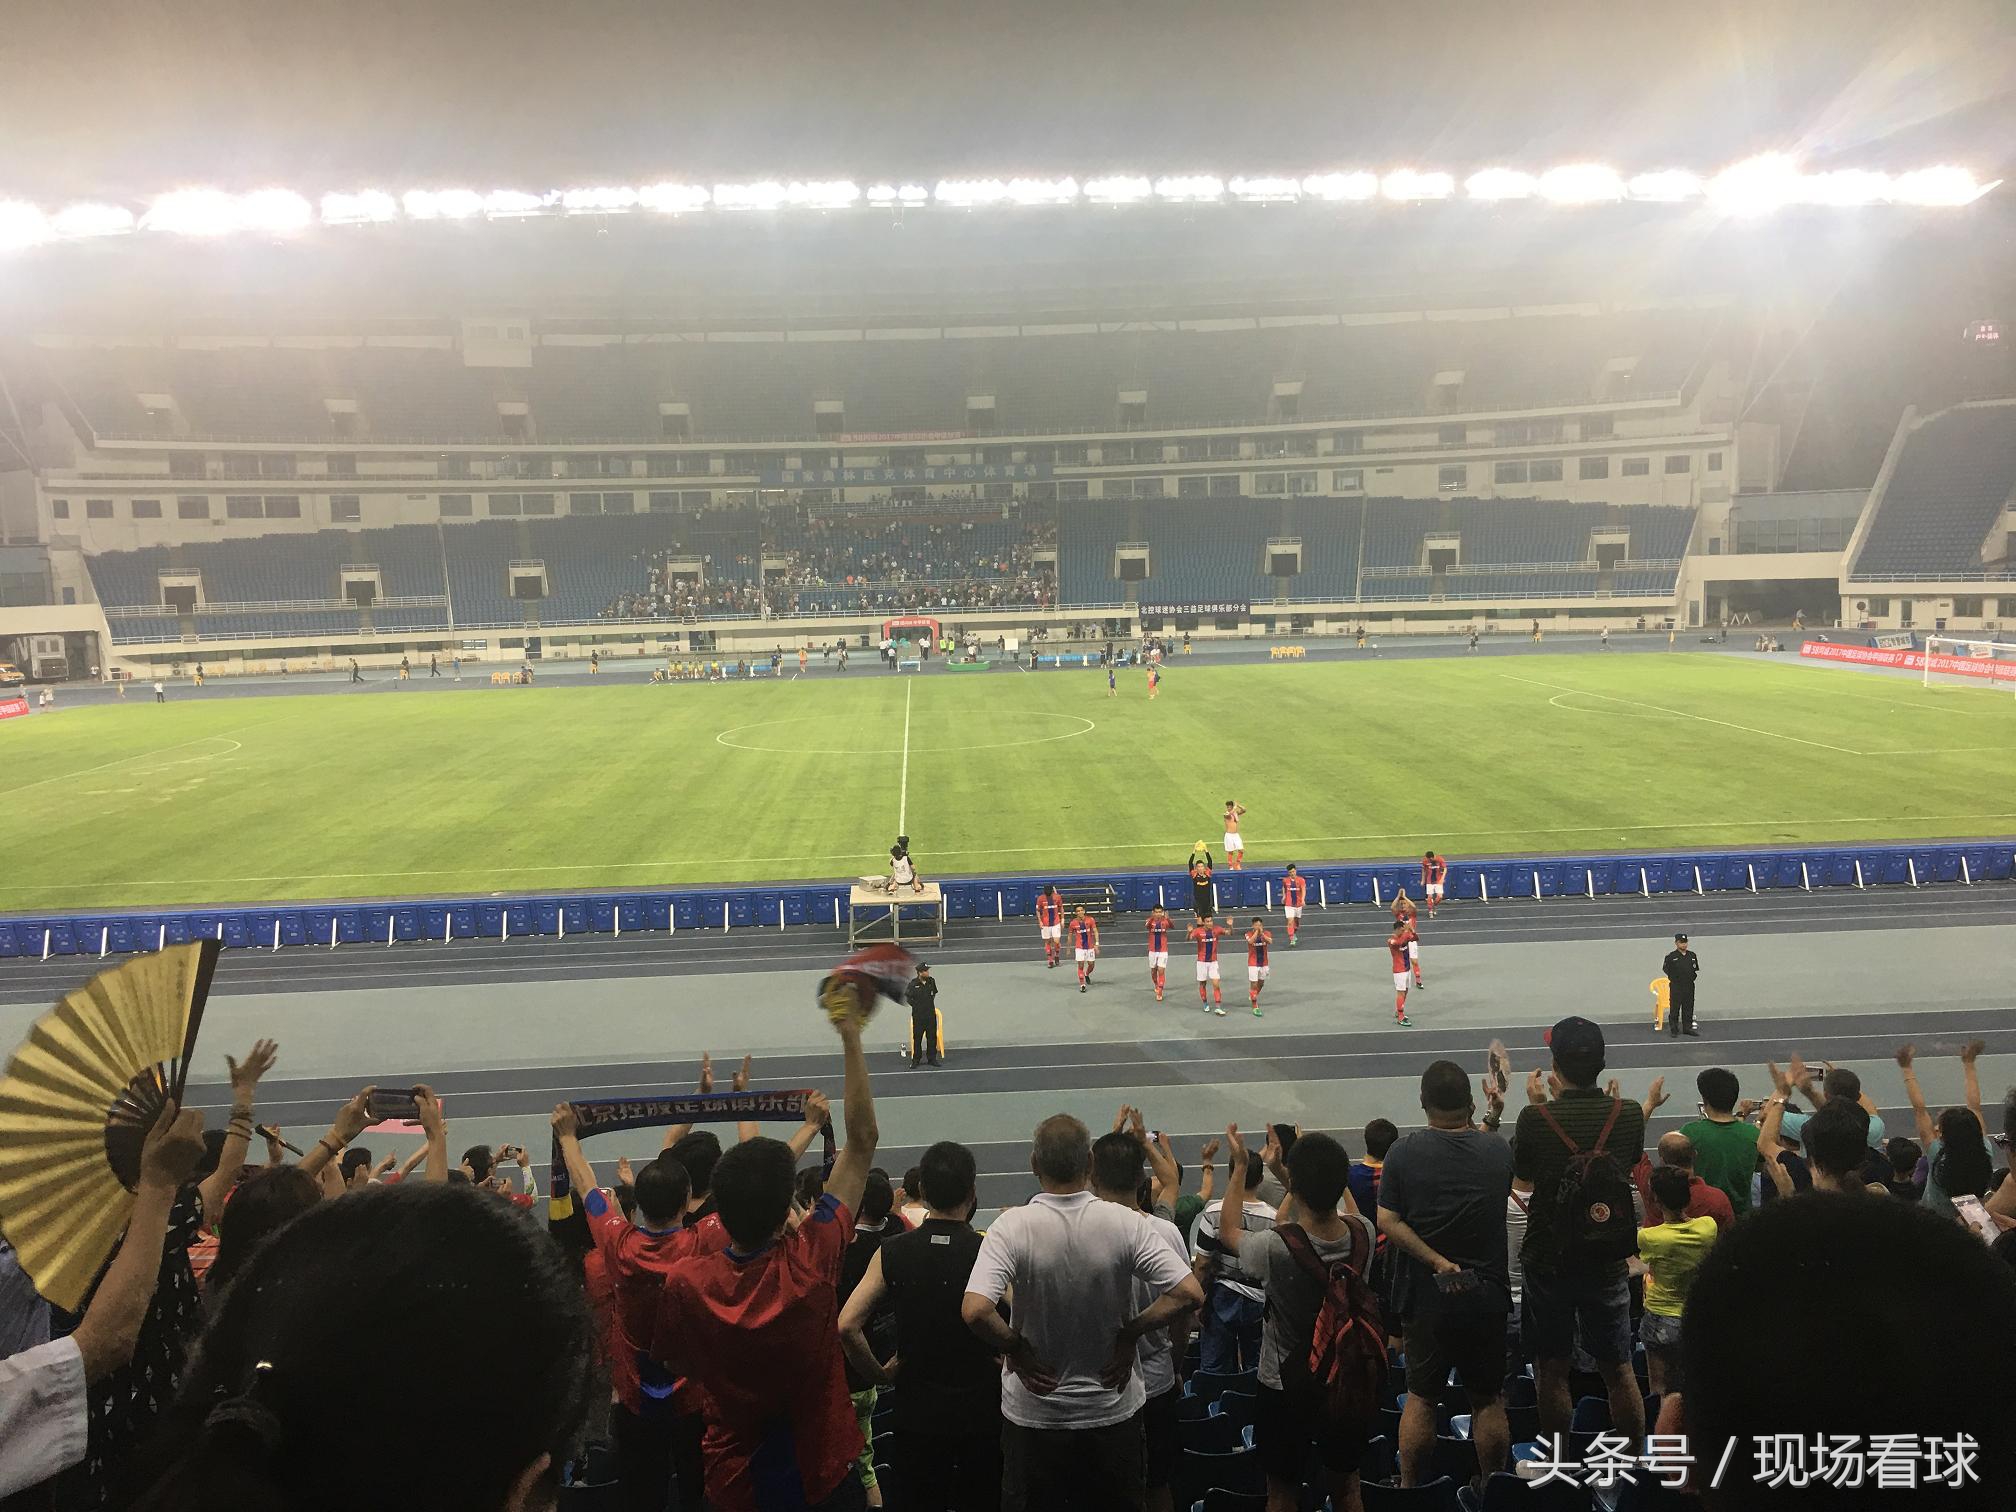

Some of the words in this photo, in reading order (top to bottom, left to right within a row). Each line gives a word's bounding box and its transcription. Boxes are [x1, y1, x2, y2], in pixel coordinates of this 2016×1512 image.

[1140, 603, 1247, 615] 北控球迷协会三益足球俱乐部分会
